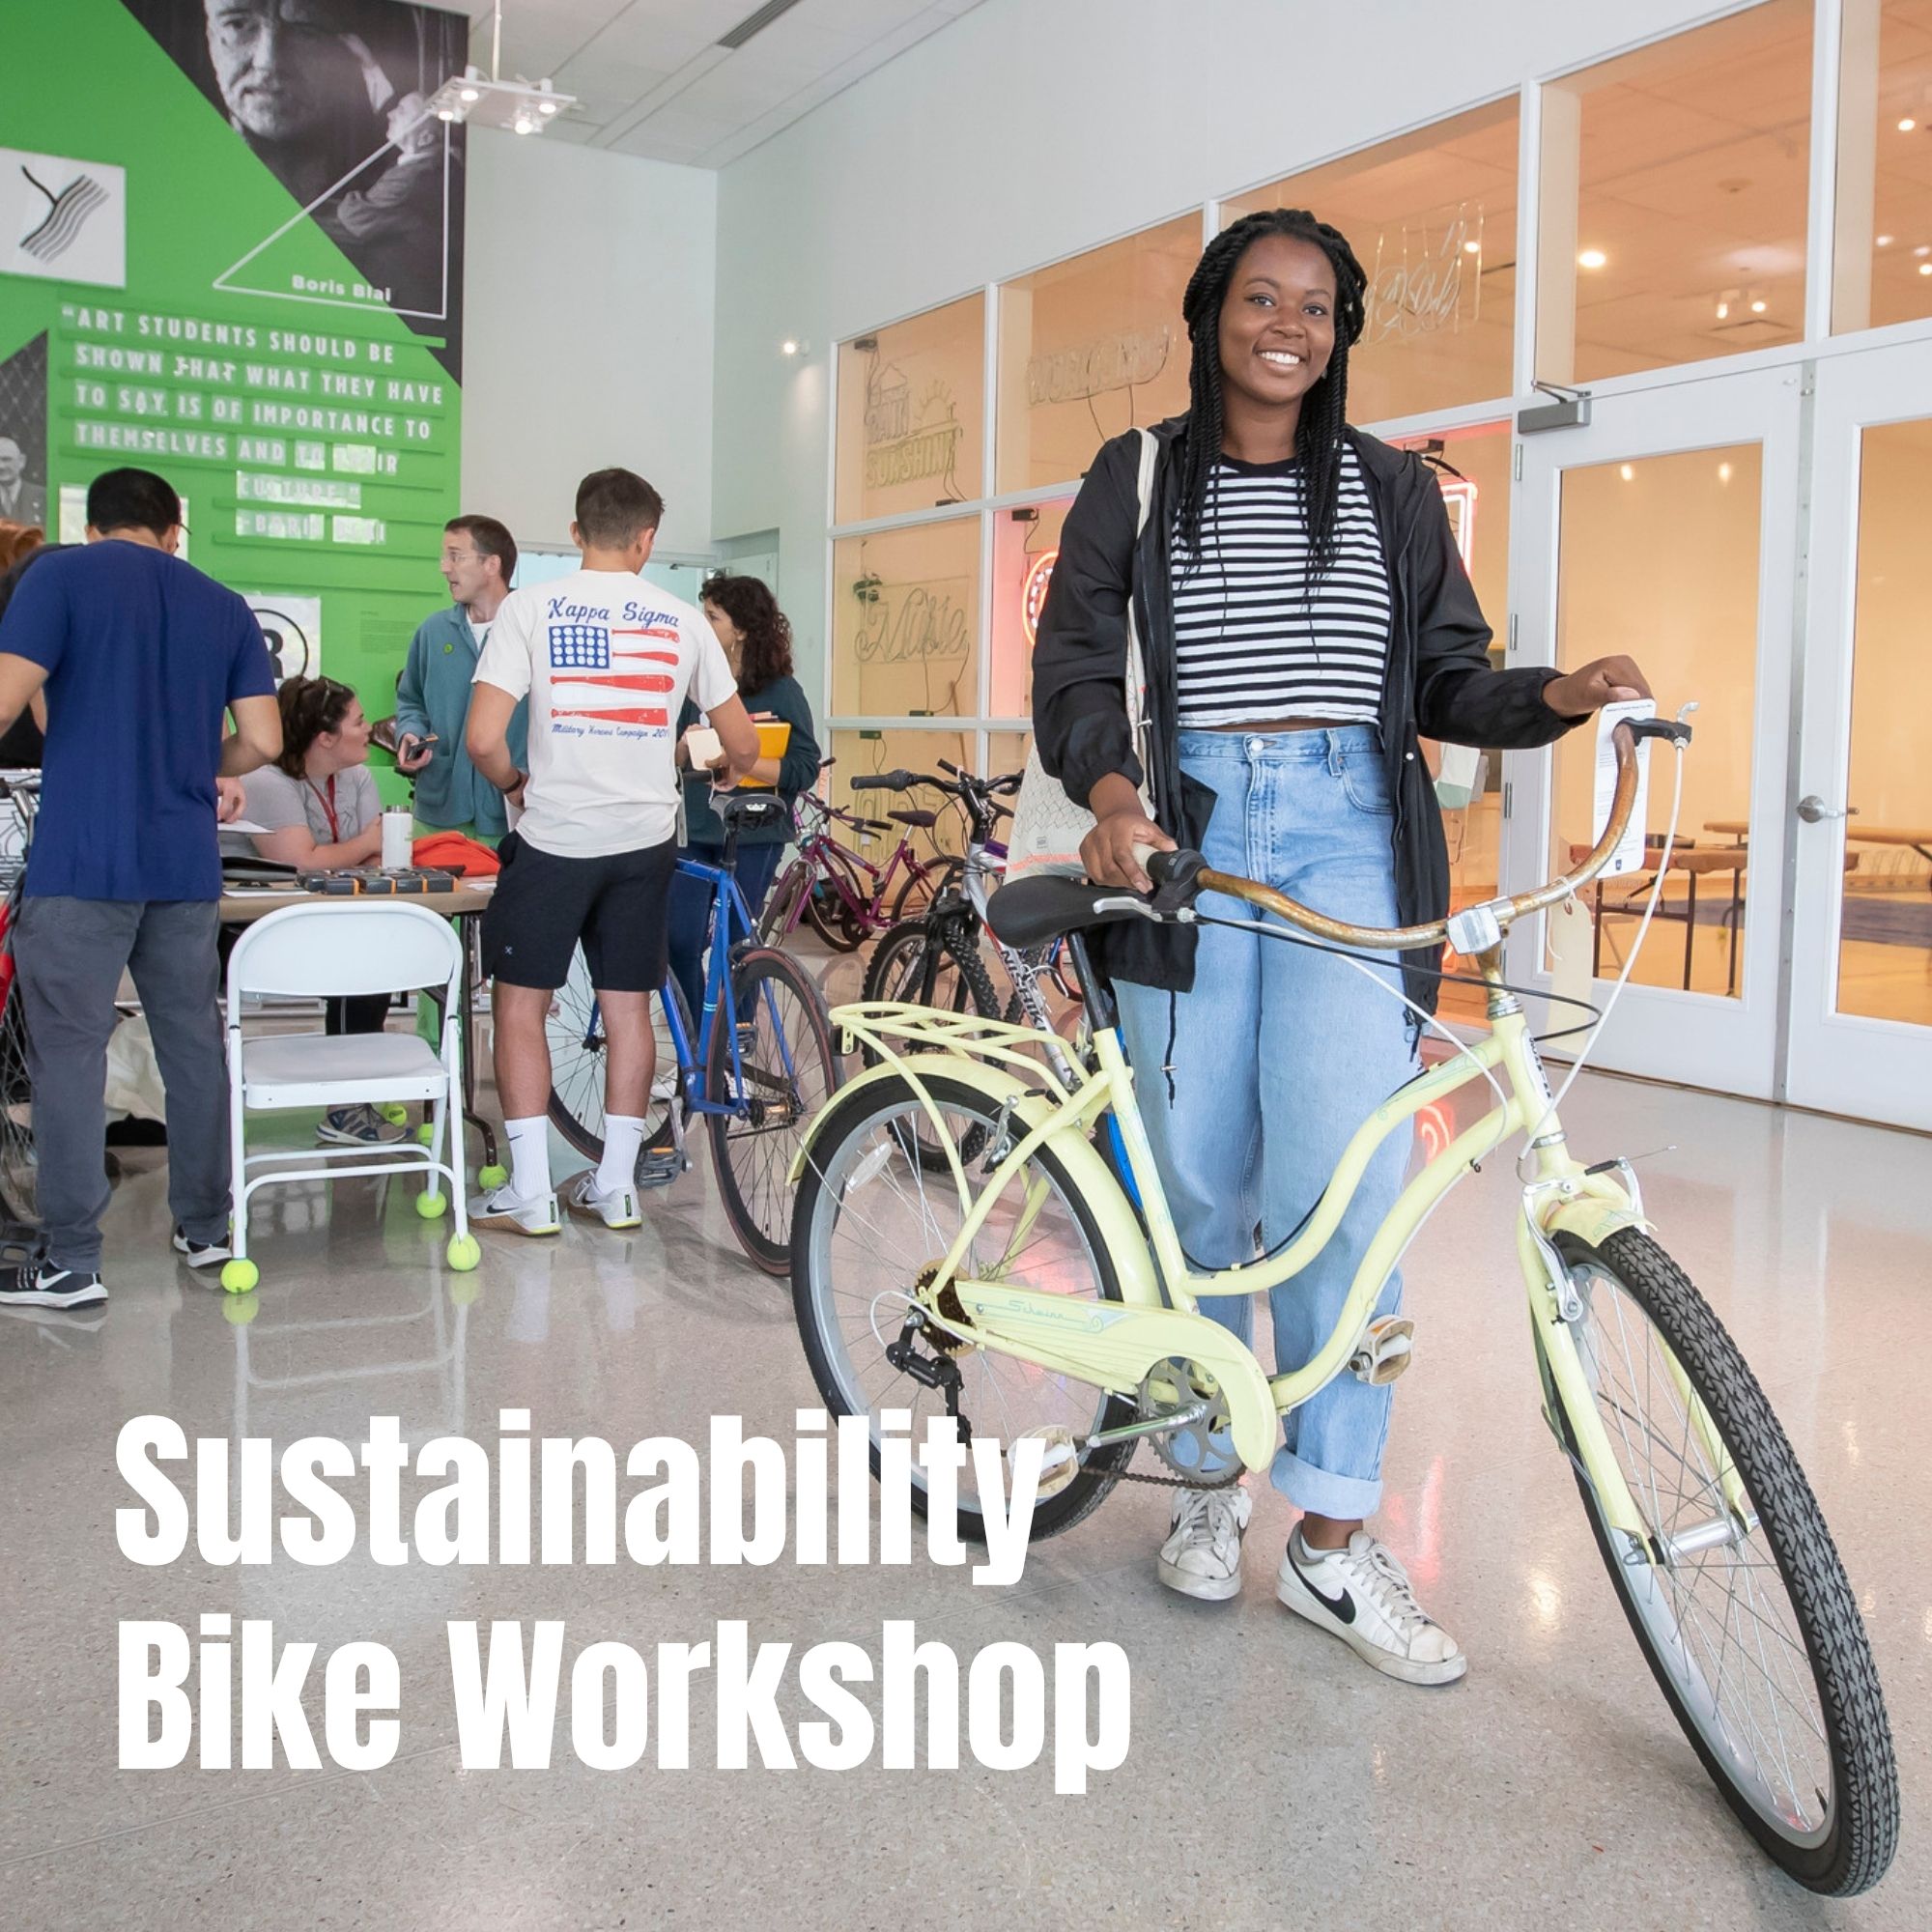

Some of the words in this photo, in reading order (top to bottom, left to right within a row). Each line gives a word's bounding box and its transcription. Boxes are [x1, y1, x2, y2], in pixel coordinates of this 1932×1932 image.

[292, 273, 345, 296] Boris
[138, 315, 257, 349] STUDENTS
[270, 331, 356, 359] SHOULD
[369, 343, 394, 364] BE
[76, 344, 163, 374] SHOWN
[174, 355, 237, 383] THAT
[246, 364, 309, 390] WHAT
[322, 373, 376, 397] THEY
[388, 381, 442, 406] HAVE
[76, 384, 106, 407] TO
[119, 388, 164, 413] SAY
[178, 394, 202, 417] IS
[214, 398, 241, 420] OF
[253, 403, 394, 437] IMPORTANCE
[406, 419, 431, 440] TO
[77, 423, 226, 457] THEMSELVES
[239, 439, 284, 461] AND
[298, 444, 324, 466] TO
[548, 596, 611, 624] Kappa
[622, 601, 679, 629] Sigma
